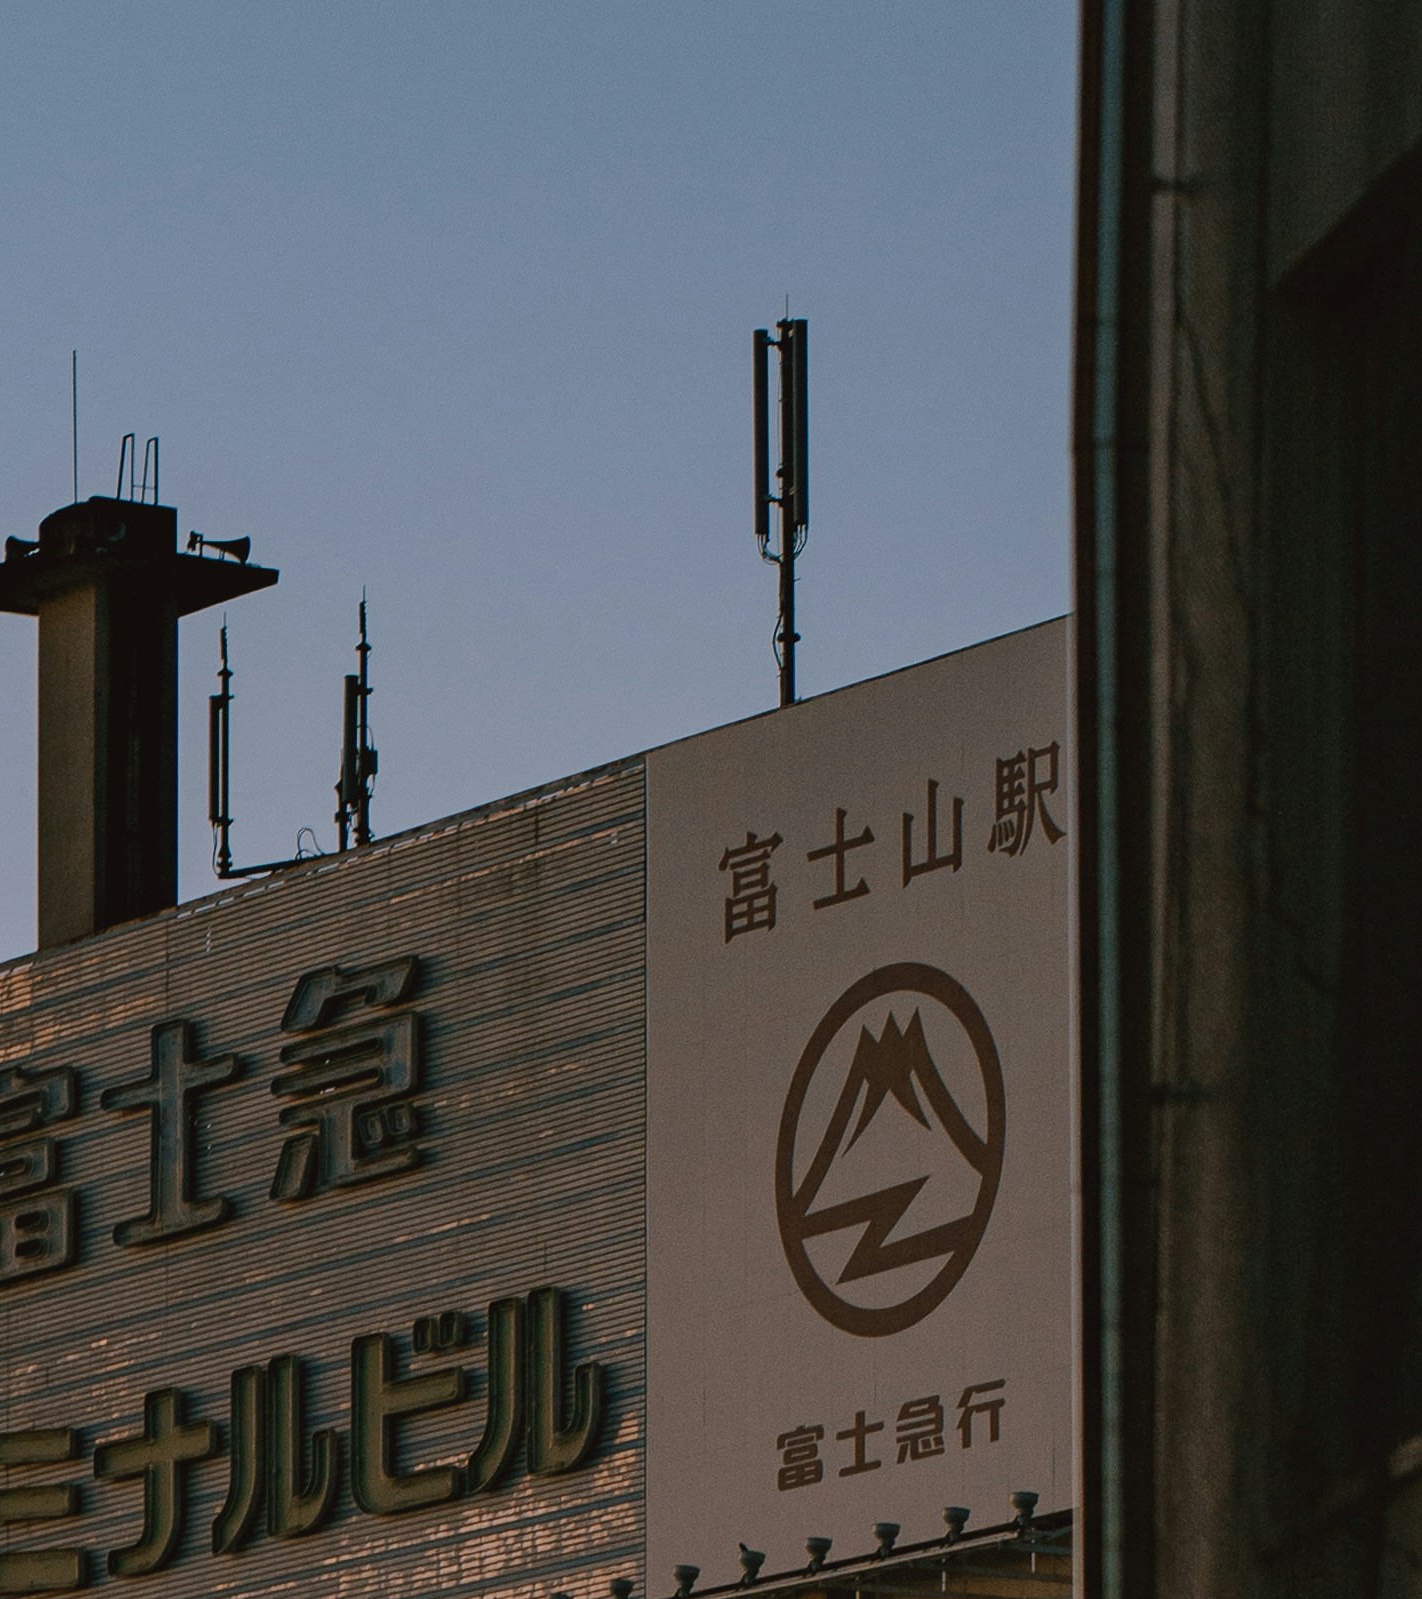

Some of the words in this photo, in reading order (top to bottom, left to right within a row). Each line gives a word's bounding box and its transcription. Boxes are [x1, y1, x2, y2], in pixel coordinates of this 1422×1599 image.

[717, 739, 1068, 945] 富士山駅
[775, 1377, 1007, 1492] 富士急行
